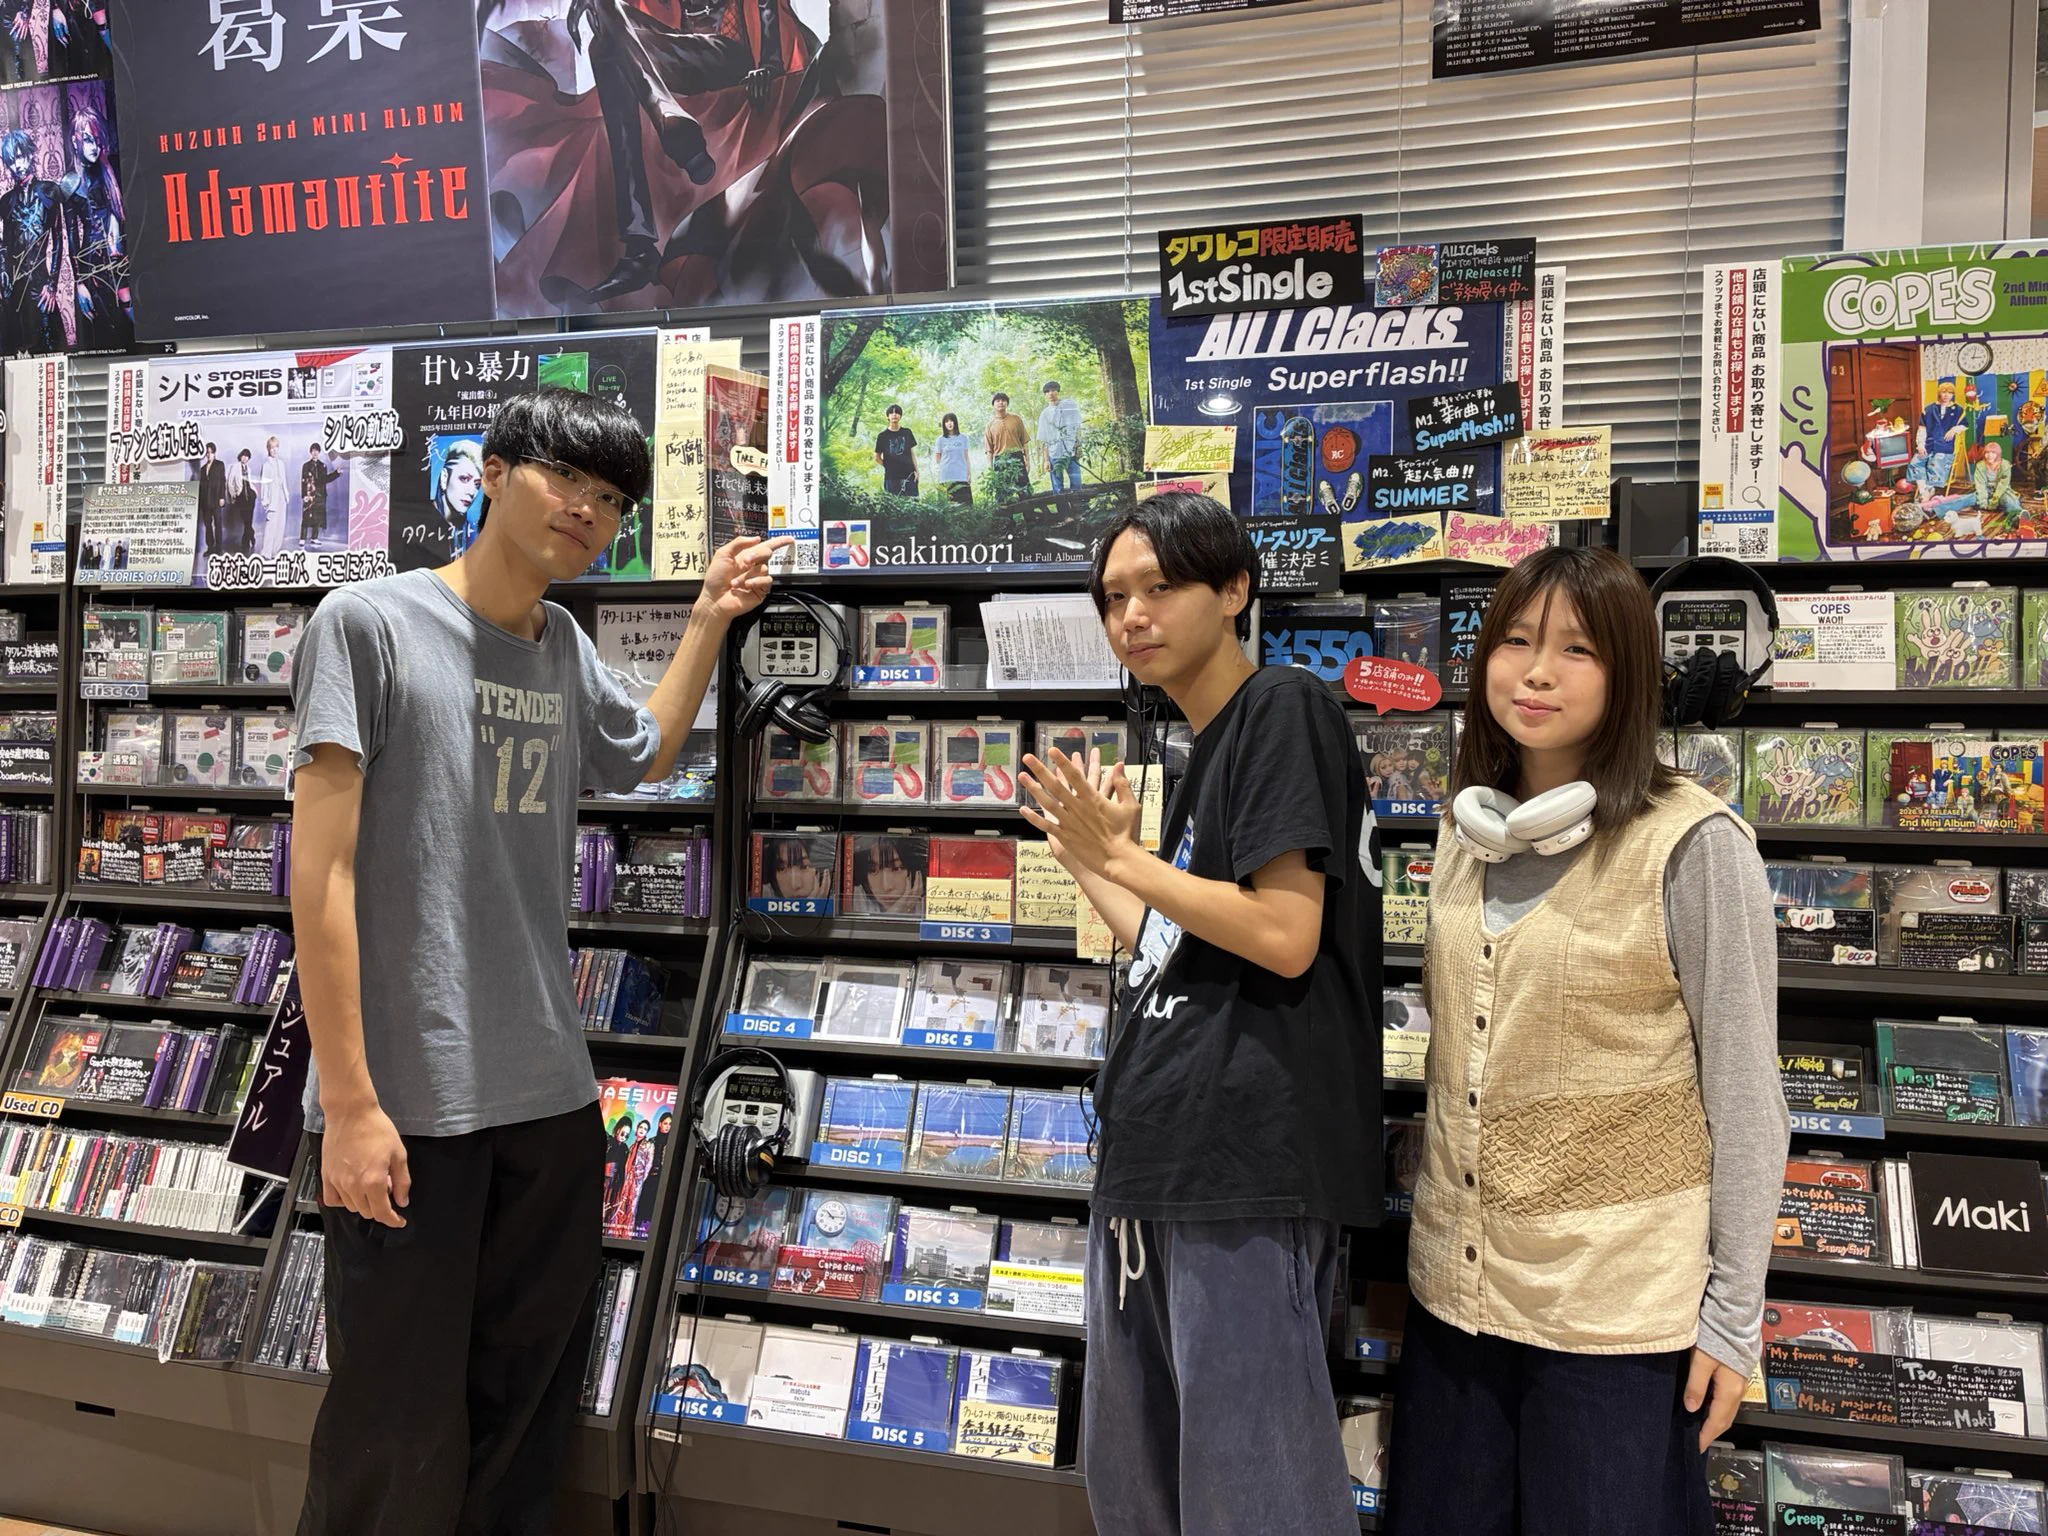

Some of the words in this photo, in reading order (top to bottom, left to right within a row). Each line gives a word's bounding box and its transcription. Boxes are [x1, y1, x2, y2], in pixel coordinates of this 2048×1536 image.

[160, 126, 242, 153] KUZUHA
[257, 120, 297, 142] 2nd
[312, 111, 368, 136] MINI
[384, 102, 464, 129] ALBUM
[162, 152, 469, 243] Adamantite
[1165, 219, 1358, 267] タワレコ限定販売
[1442, 269, 1463, 281] 10.7
[2003, 282, 2025, 293] 2nd
[2010, 295, 2047, 306] Album
[1539, 274, 1554, 363] 店頭にない商品
[1751, 268, 1768, 359] 店頭にない商品
[804, 322, 816, 400] 店頭にない商品
[1712, 270, 1724, 443] スタッフまでお気軽にお問い合わせください!
[1728, 271, 1745, 432] 他店舗の在庫もお探しします!
[208, 368, 283, 383] STORIES
[420, 350, 531, 386] 甘い暴力
[1185, 379, 1204, 391] 1st
[1208, 376, 1252, 392] Single
[1267, 358, 1468, 394] Superflash!!
[159, 373, 202, 403] シド
[208, 382, 234, 398] of
[237, 379, 282, 397] SID
[602, 375, 618, 384] LIVE
[180, 405, 259, 418] リクエストベストアルバム
[323, 412, 402, 450] シドの軌跡。
[1415, 413, 1516, 451] Superflash!!
[1748, 363, 1766, 485] お取り寄せします!
[735, 450, 754, 464] TAKE
[801, 404, 815, 506] お取り寄せします!
[1372, 467, 1394, 479] M2.
[1403, 464, 1475, 484] 超人気曲!!
[1374, 483, 1470, 509] SUMMER
[875, 534, 1014, 566] sakimori
[1020, 552, 1033, 563] 1st
[1035, 551, 1053, 562] Full
[1055, 550, 1085, 562] Album
[1259, 551, 1316, 570] 催決定
[146, 571, 158, 582] of
[600, 609, 648, 626] タワーレコード
[1811, 604, 1851, 614] COPES
[1818, 616, 1844, 625] WAO!!
[1775, 648, 1807, 660] WAO!!
[880, 669, 909, 681] DISC
[915, 669, 922, 680] 1
[1360, 661, 1425, 687] 5店舗のみ!!
[1904, 652, 1990, 688] WAO!!
[84, 683, 122, 697] disc
[124, 683, 139, 697] 4
[474, 678, 563, 725] TENDER
[112, 754, 138, 766] 通常盤
[1990, 744, 2038, 760] COPES
[1390, 802, 1426, 814] DISC
[1758, 791, 1841, 822] WAO!!
[1899, 818, 1919, 828] 2nd
[1920, 818, 1942, 828] Mini
[1943, 818, 1976, 828] Album
[768, 901, 802, 913] DISC
[805, 901, 816, 913] 2
[941, 926, 976, 939] DISC
[981, 928, 991, 940] 3
[743, 1019, 782, 1034] DISC
[784, 1022, 796, 1035] 4
[925, 1032, 961, 1047] DISC
[963, 1034, 974, 1047] 5
[1893, 1065, 1935, 1089] May
[4, 1095, 38, 1115] Used
[40, 1100, 60, 1117] CD
[1838, 1119, 1853, 1133] 4
[831, 1149, 870, 1165] DISC
[876, 1152, 883, 1166] 1
[0, 1206, 21, 1223] CD
[1932, 1196, 2031, 1233] Maki
[818, 1259, 842, 1271] Carpe
[713, 1270, 746, 1284] DISC
[748, 1273, 759, 1286] 2
[904, 1289, 943, 1304] DISC
[948, 1291, 960, 1305] 3
[1792, 1347, 1827, 1361] favorite
[674, 1400, 710, 1416] DISC
[712, 1404, 724, 1419] 4
[1797, 1392, 1836, 1415] Maki
[1840, 1399, 1876, 1412] major
[1876, 1400, 1893, 1413] 1st
[1953, 1408, 1993, 1429] Maki
[872, 1426, 908, 1444] DISC
[913, 1431, 925, 1446] 5
